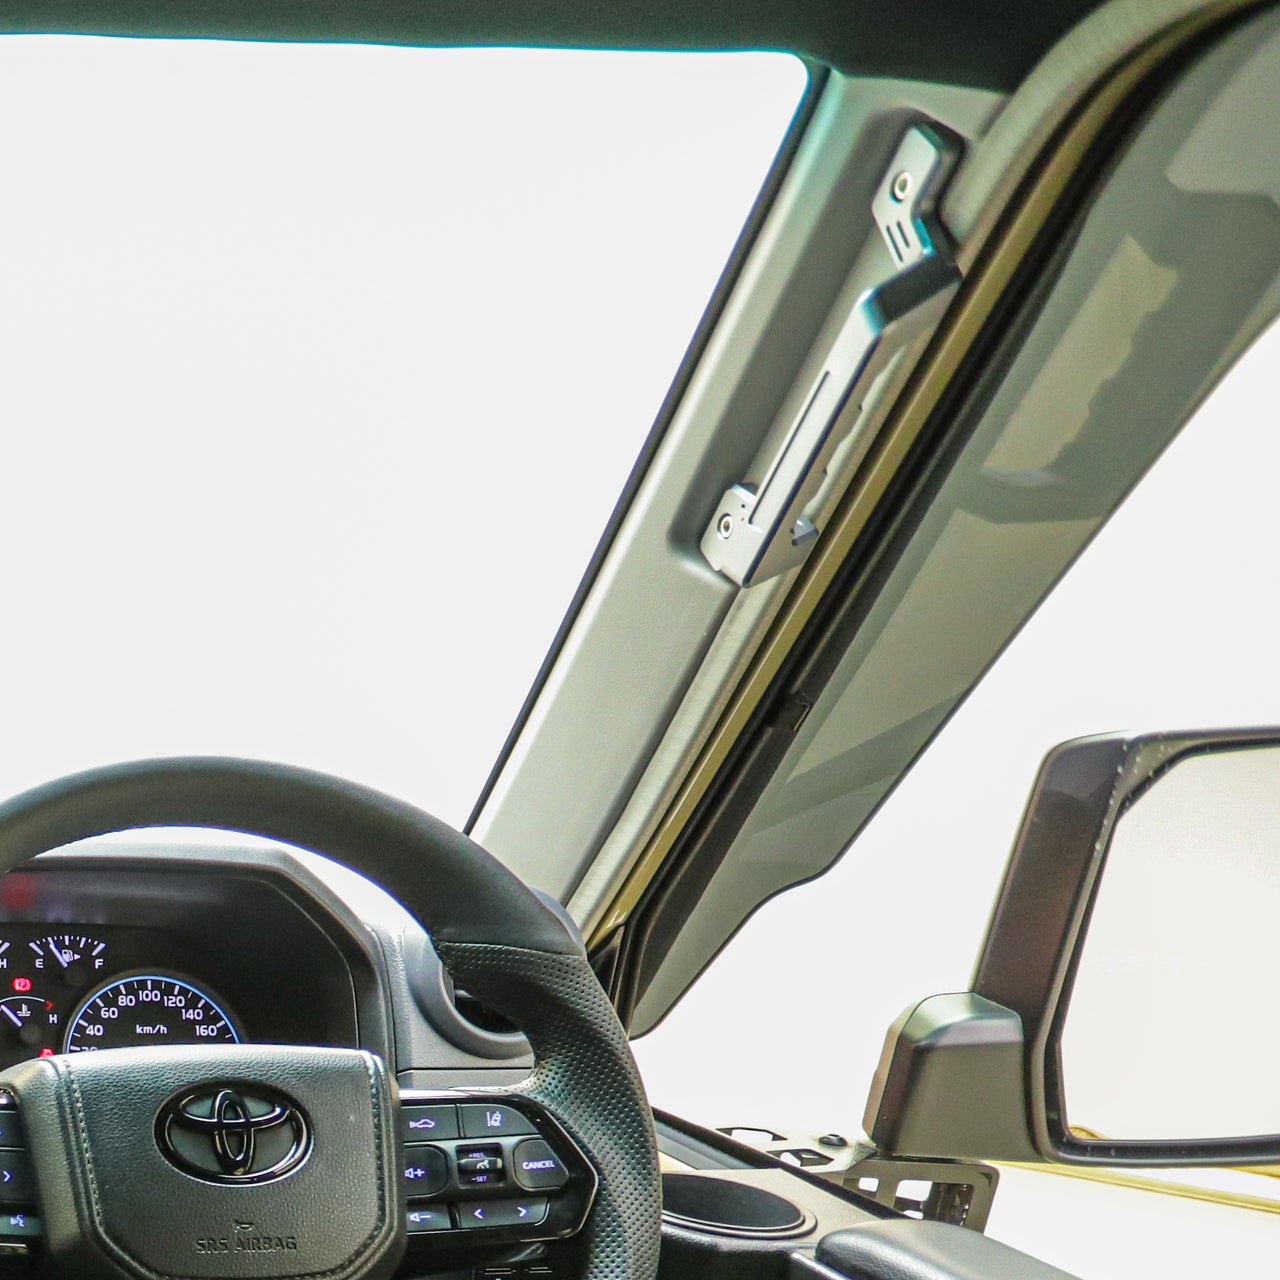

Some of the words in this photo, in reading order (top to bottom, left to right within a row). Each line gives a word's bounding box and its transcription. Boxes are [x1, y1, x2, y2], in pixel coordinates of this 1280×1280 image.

[35, 958, 44, 969] E
[94, 958, 105, 969] F
[117, 995, 136, 1007] 80
[138, 990, 161, 1001] 100
[163, 995, 185, 1007] 120
[48, 1013, 58, 1024] H
[100, 1007, 119, 1019] 60
[181, 1008, 204, 1020] 140
[85, 1024, 104, 1036] 40
[135, 1023, 168, 1034] km/h
[195, 1024, 218, 1036] 160
[522, 1160, 556, 1170] CANCEL
[196, 1238, 229, 1254] SRS
[234, 1236, 297, 1253] AIRBAG
